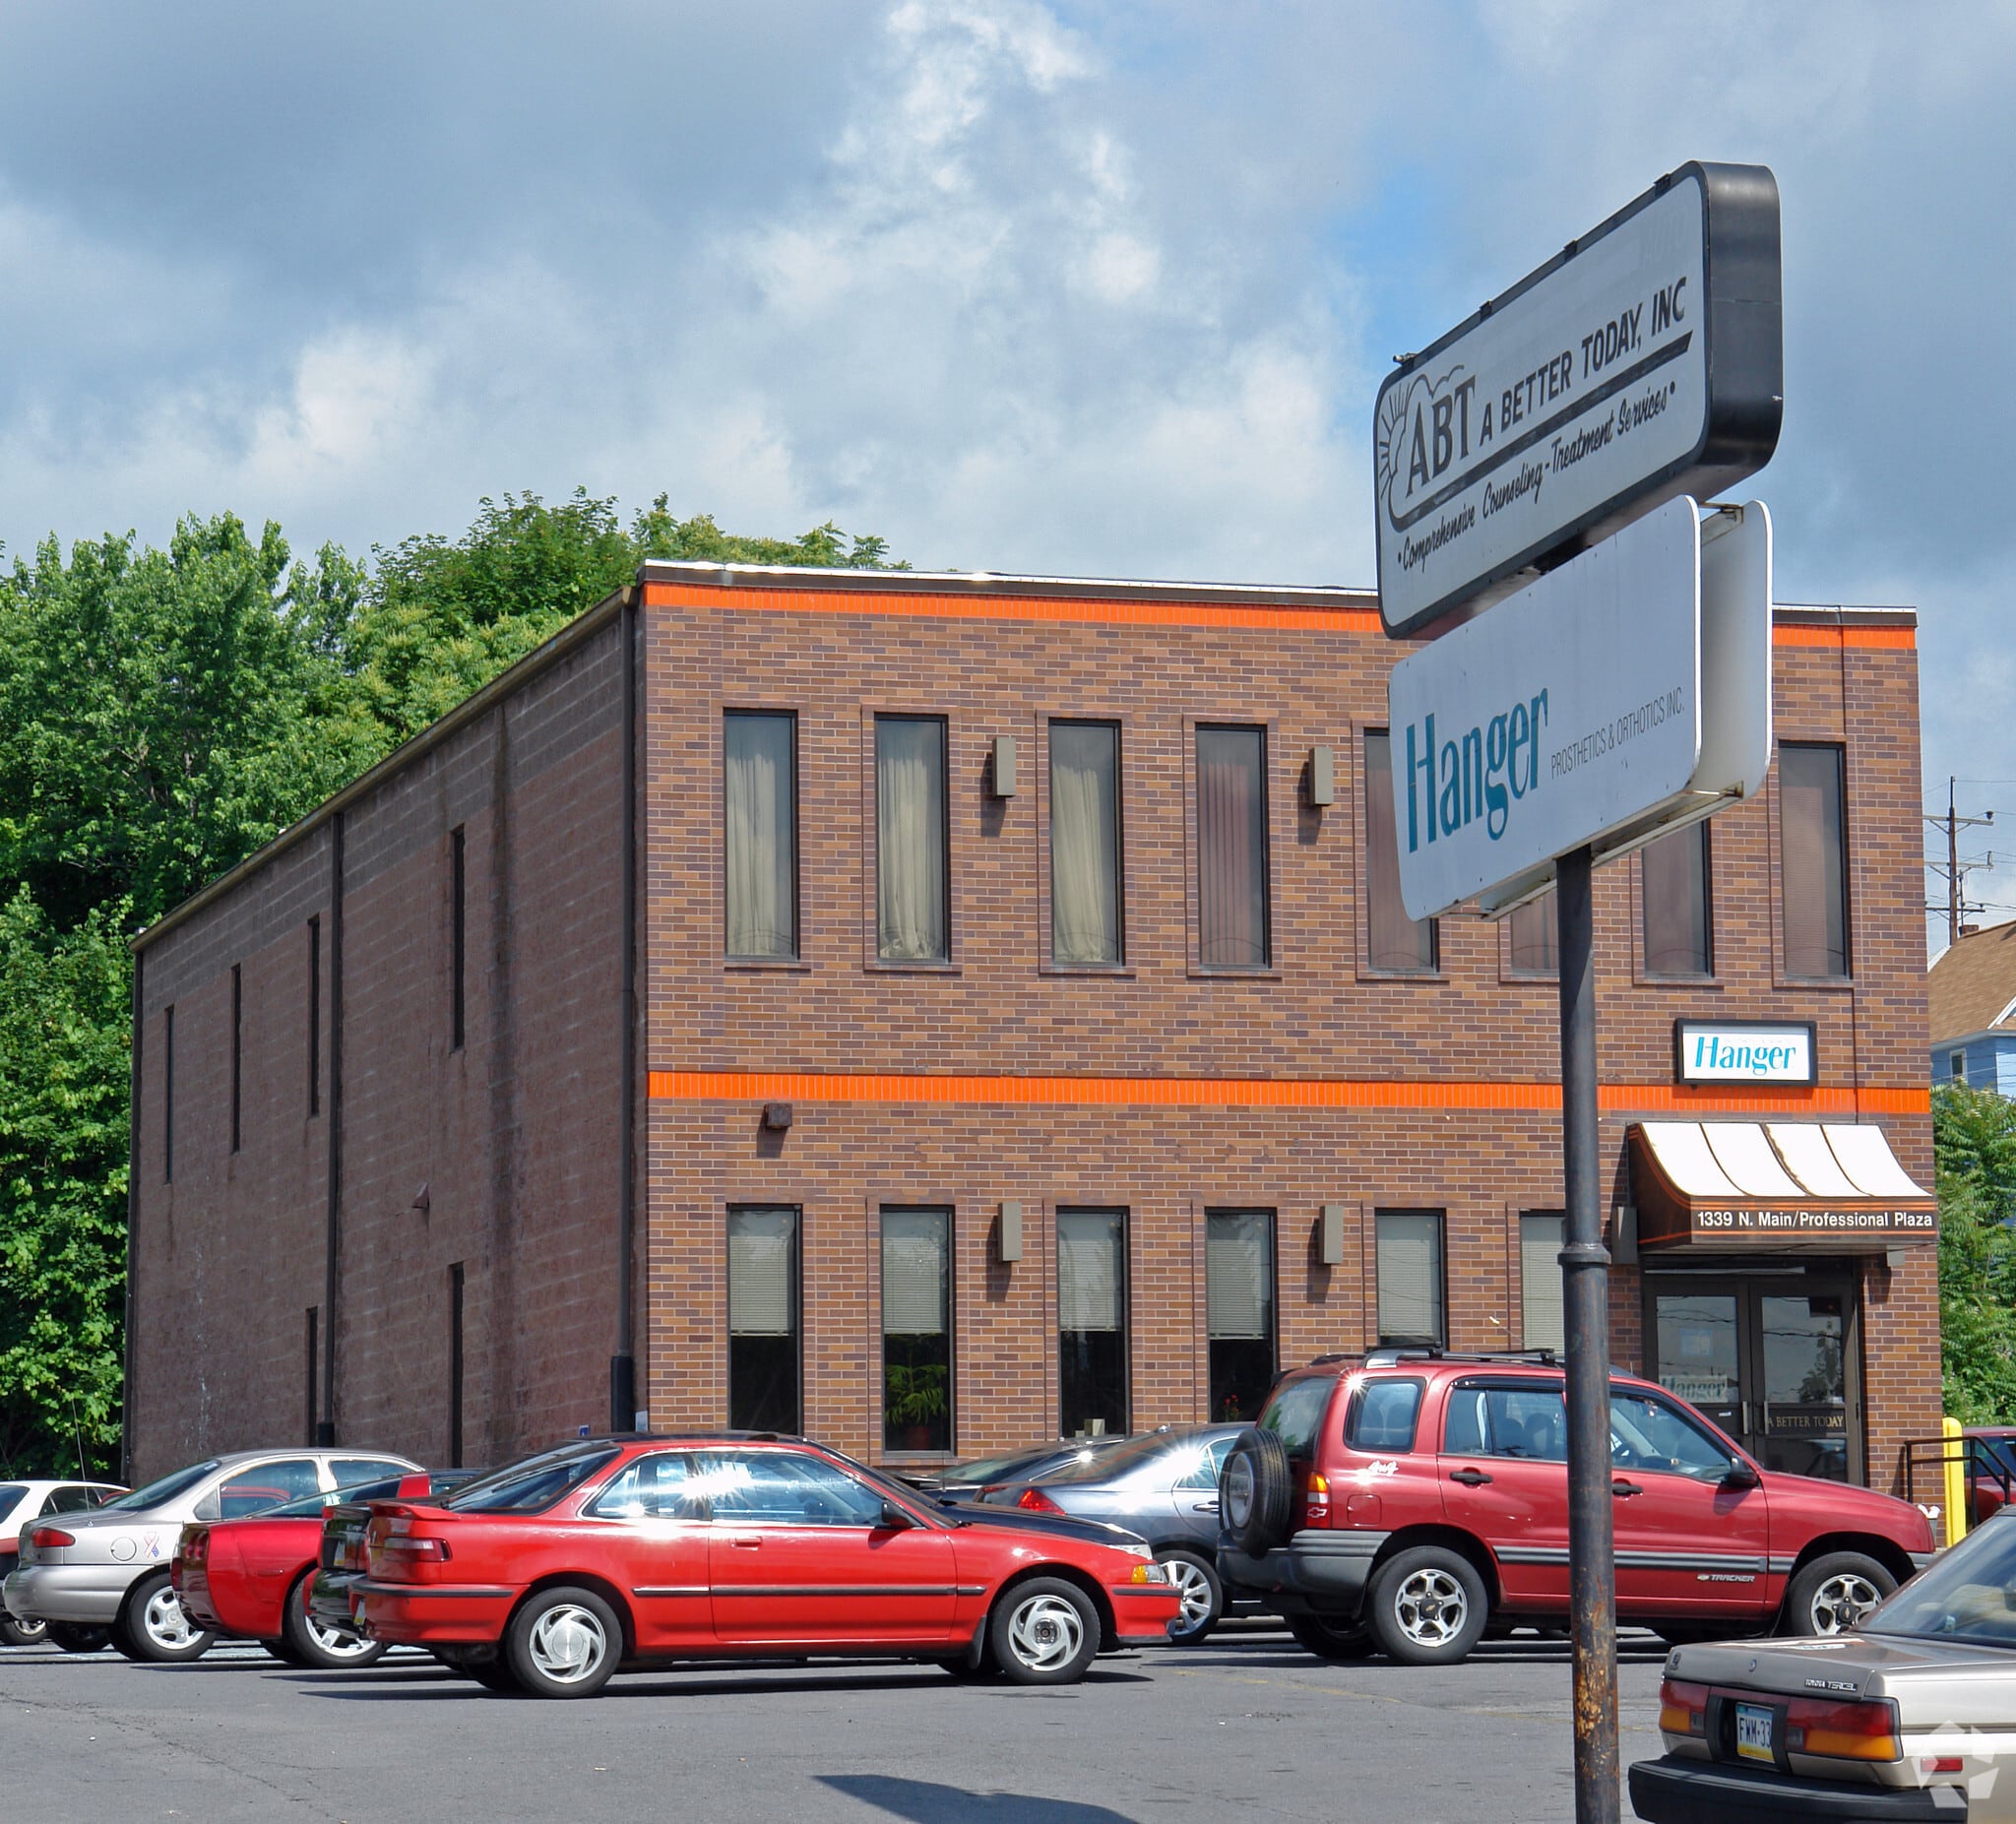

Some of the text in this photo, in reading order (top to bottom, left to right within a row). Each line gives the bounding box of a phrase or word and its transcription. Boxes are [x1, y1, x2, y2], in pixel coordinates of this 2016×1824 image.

[1480, 276, 1687, 447] A BETTER TODAY, INC
[1403, 504, 1476, 573] Comprehensive
[1482, 463, 1544, 519] Counseling
[1551, 409, 1614, 473] Treatment
[1617, 386, 1668, 436] Services
[1406, 374, 1476, 498] ABT
[1406, 687, 1548, 853] Hanger
[1550, 686, 1684, 780] PROSTHETICS & ORTHOTICS INC.
[1695, 1037, 1796, 1076] Hanger
[1697, 1211, 1732, 1226] 1339
[1738, 1212, 1753, 1226] N.
[1894, 1211, 1933, 1226] Plaza
[1776, 1415, 1810, 1427] BETTER
[1814, 1415, 1844, 1427] TODAY
[1711, 1574, 1755, 1583] TRACKER
